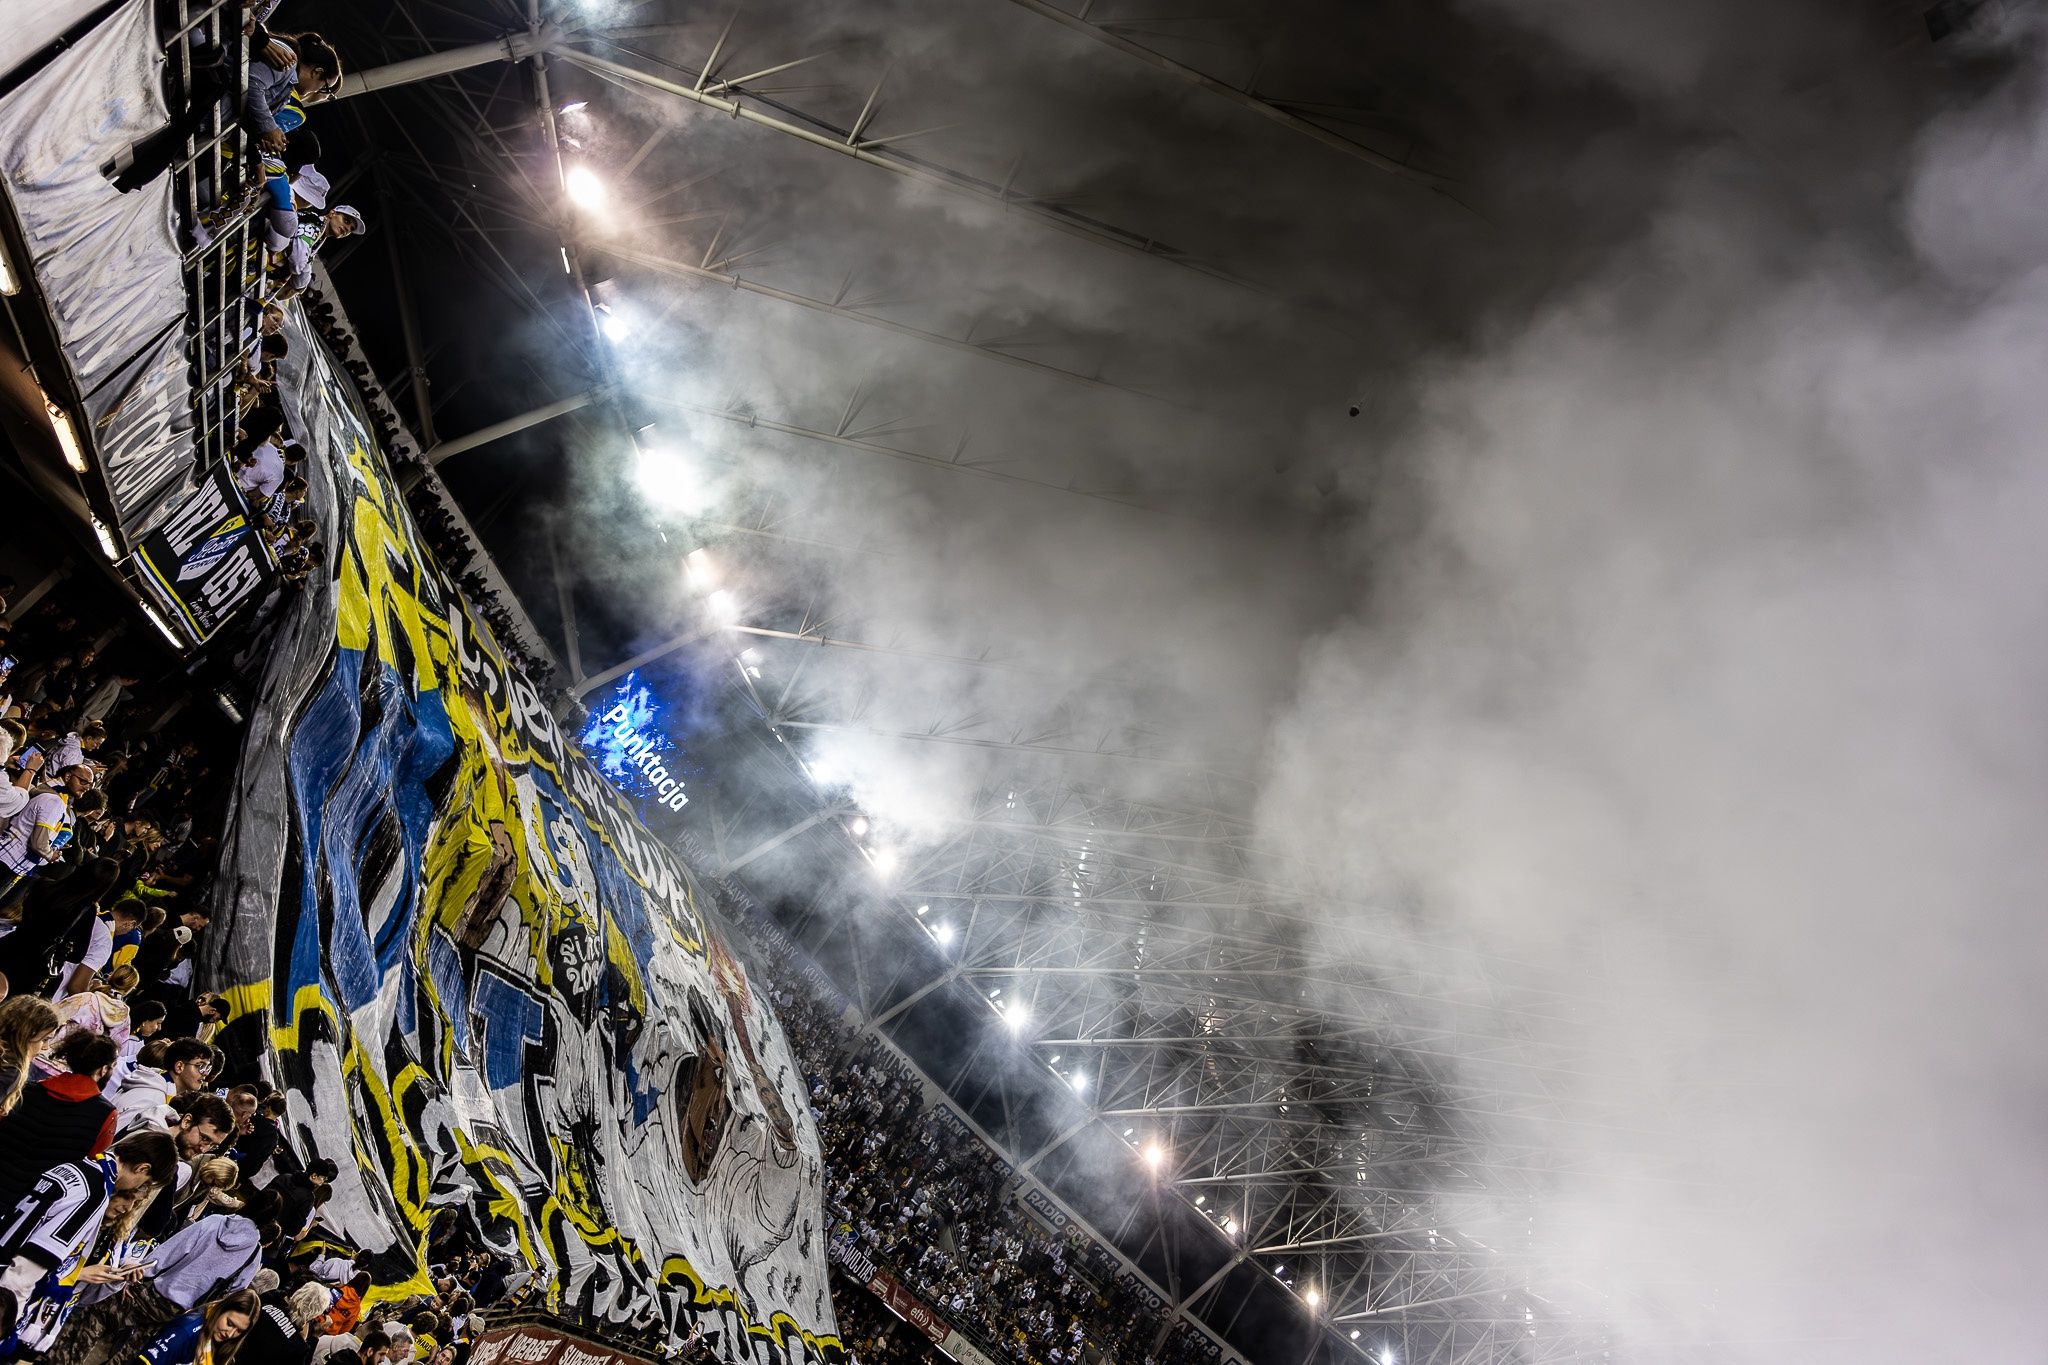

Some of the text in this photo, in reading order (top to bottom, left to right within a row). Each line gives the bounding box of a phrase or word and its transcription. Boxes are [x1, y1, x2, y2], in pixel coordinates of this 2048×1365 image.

[103, 388, 190, 513] TORUŃ
[600, 703, 691, 812] Punktacja
[759, 919, 798, 960] KUJAWY
[1027, 1190, 1066, 1227] RADIO
[841, 1244, 878, 1283] WOJTAS
[262, 1304, 297, 1339] OCHRONA
[1159, 1305, 1188, 1332] GA
